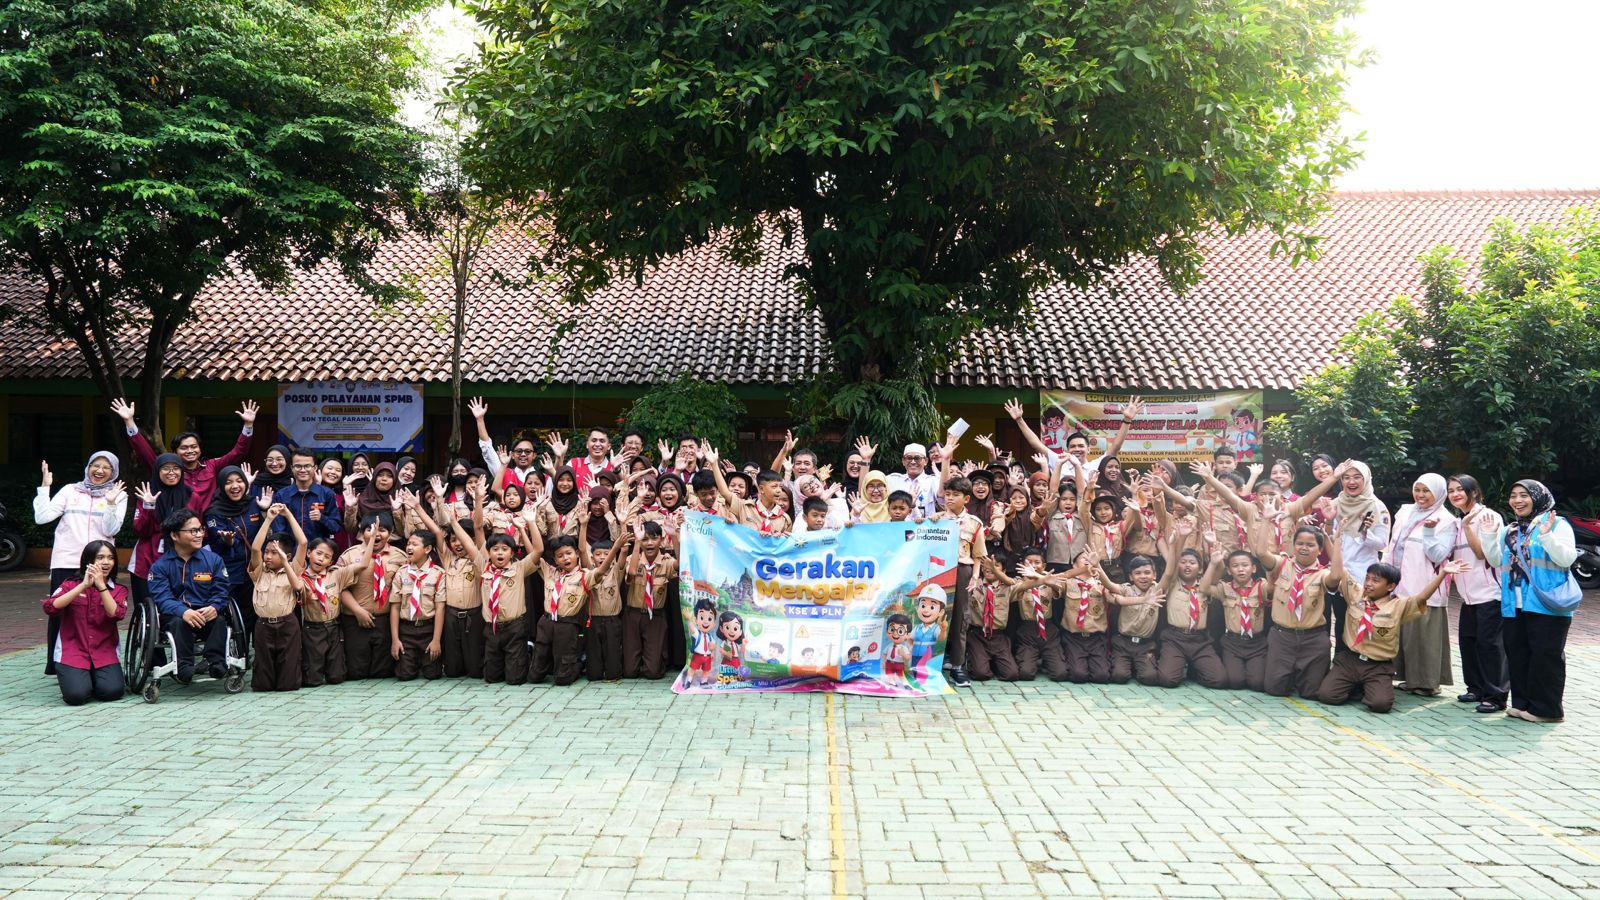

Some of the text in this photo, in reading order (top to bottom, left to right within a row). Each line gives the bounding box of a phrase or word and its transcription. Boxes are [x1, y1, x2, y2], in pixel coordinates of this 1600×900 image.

[284, 394, 413, 403] POSKO PELAYANAN SPMB
[1167, 419, 1197, 430] KELAS
[1198, 419, 1228, 430] AKHIR
[686, 522, 713, 537] Peduli
[916, 534, 948, 542] Indonesia
[755, 553, 875, 581] Gerakan
[755, 579, 881, 606] Mengajar
[788, 606, 842, 617] KSE & PLN
